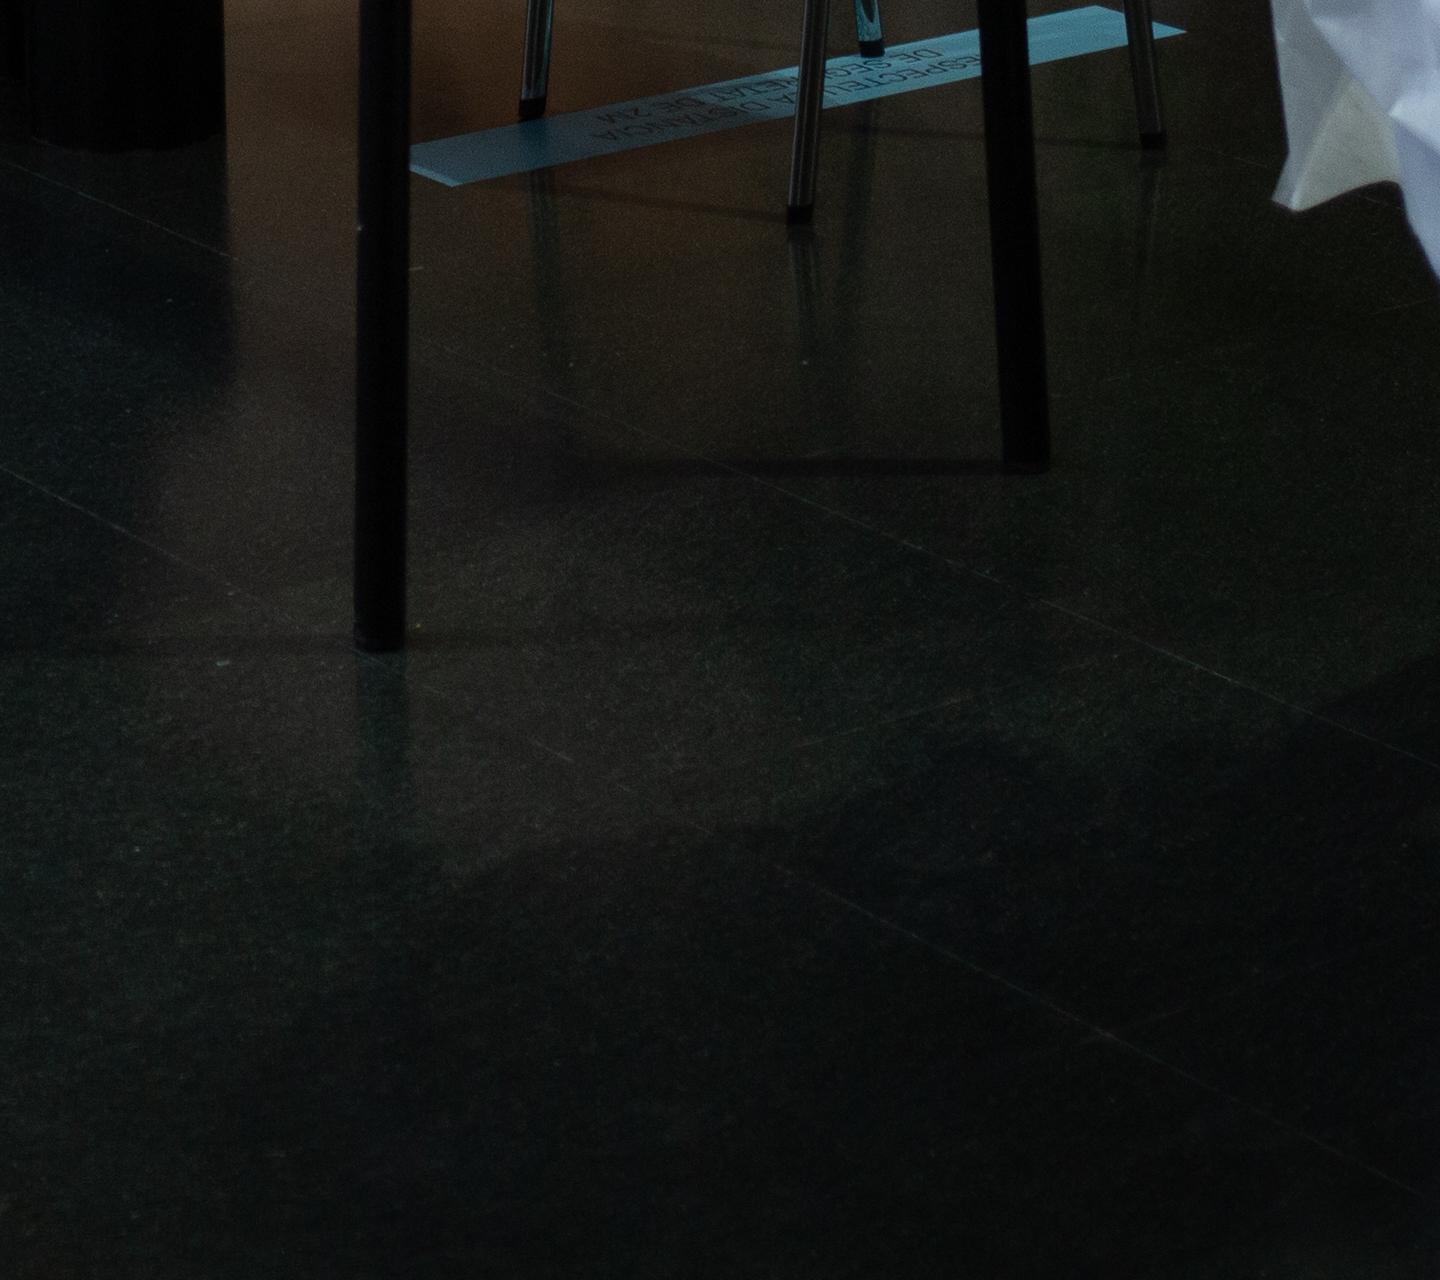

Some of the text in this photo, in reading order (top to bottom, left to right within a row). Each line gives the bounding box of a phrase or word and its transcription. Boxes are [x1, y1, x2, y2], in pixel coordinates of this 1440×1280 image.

[889, 48, 944, 64] DE
[823, 54, 983, 97] ESPECTEU
[654, 96, 706, 108] DE
